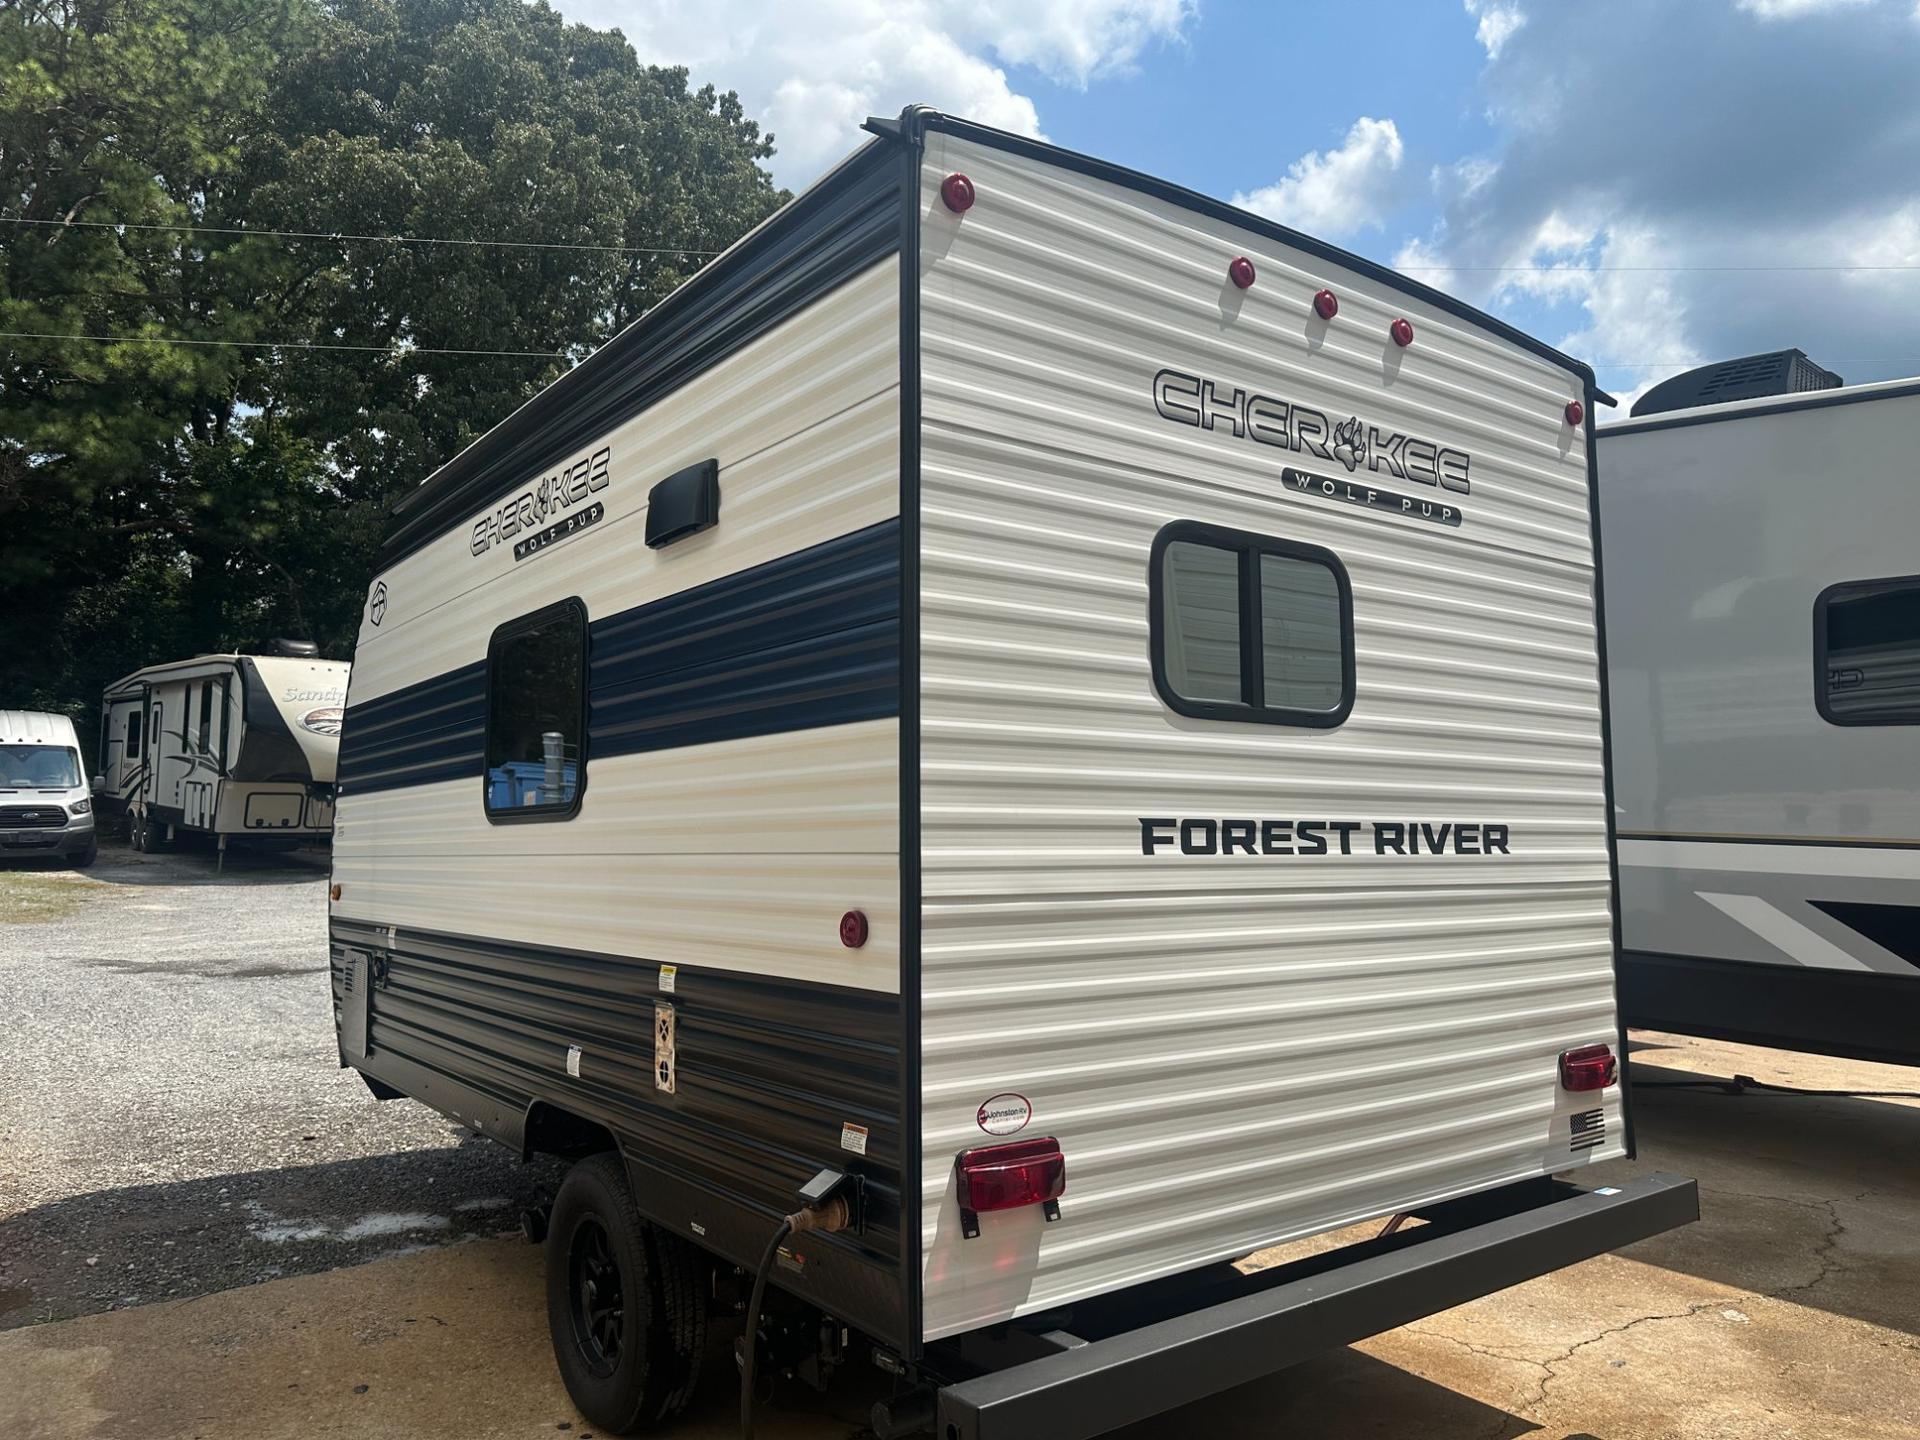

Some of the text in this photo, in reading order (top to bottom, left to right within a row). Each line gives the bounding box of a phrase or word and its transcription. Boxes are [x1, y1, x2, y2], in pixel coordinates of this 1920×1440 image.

[1294, 472, 1452, 522] WOLF PUP
[517, 506, 598, 556] WOLF PUP
[1138, 817, 1511, 856] FOREST RIVER
